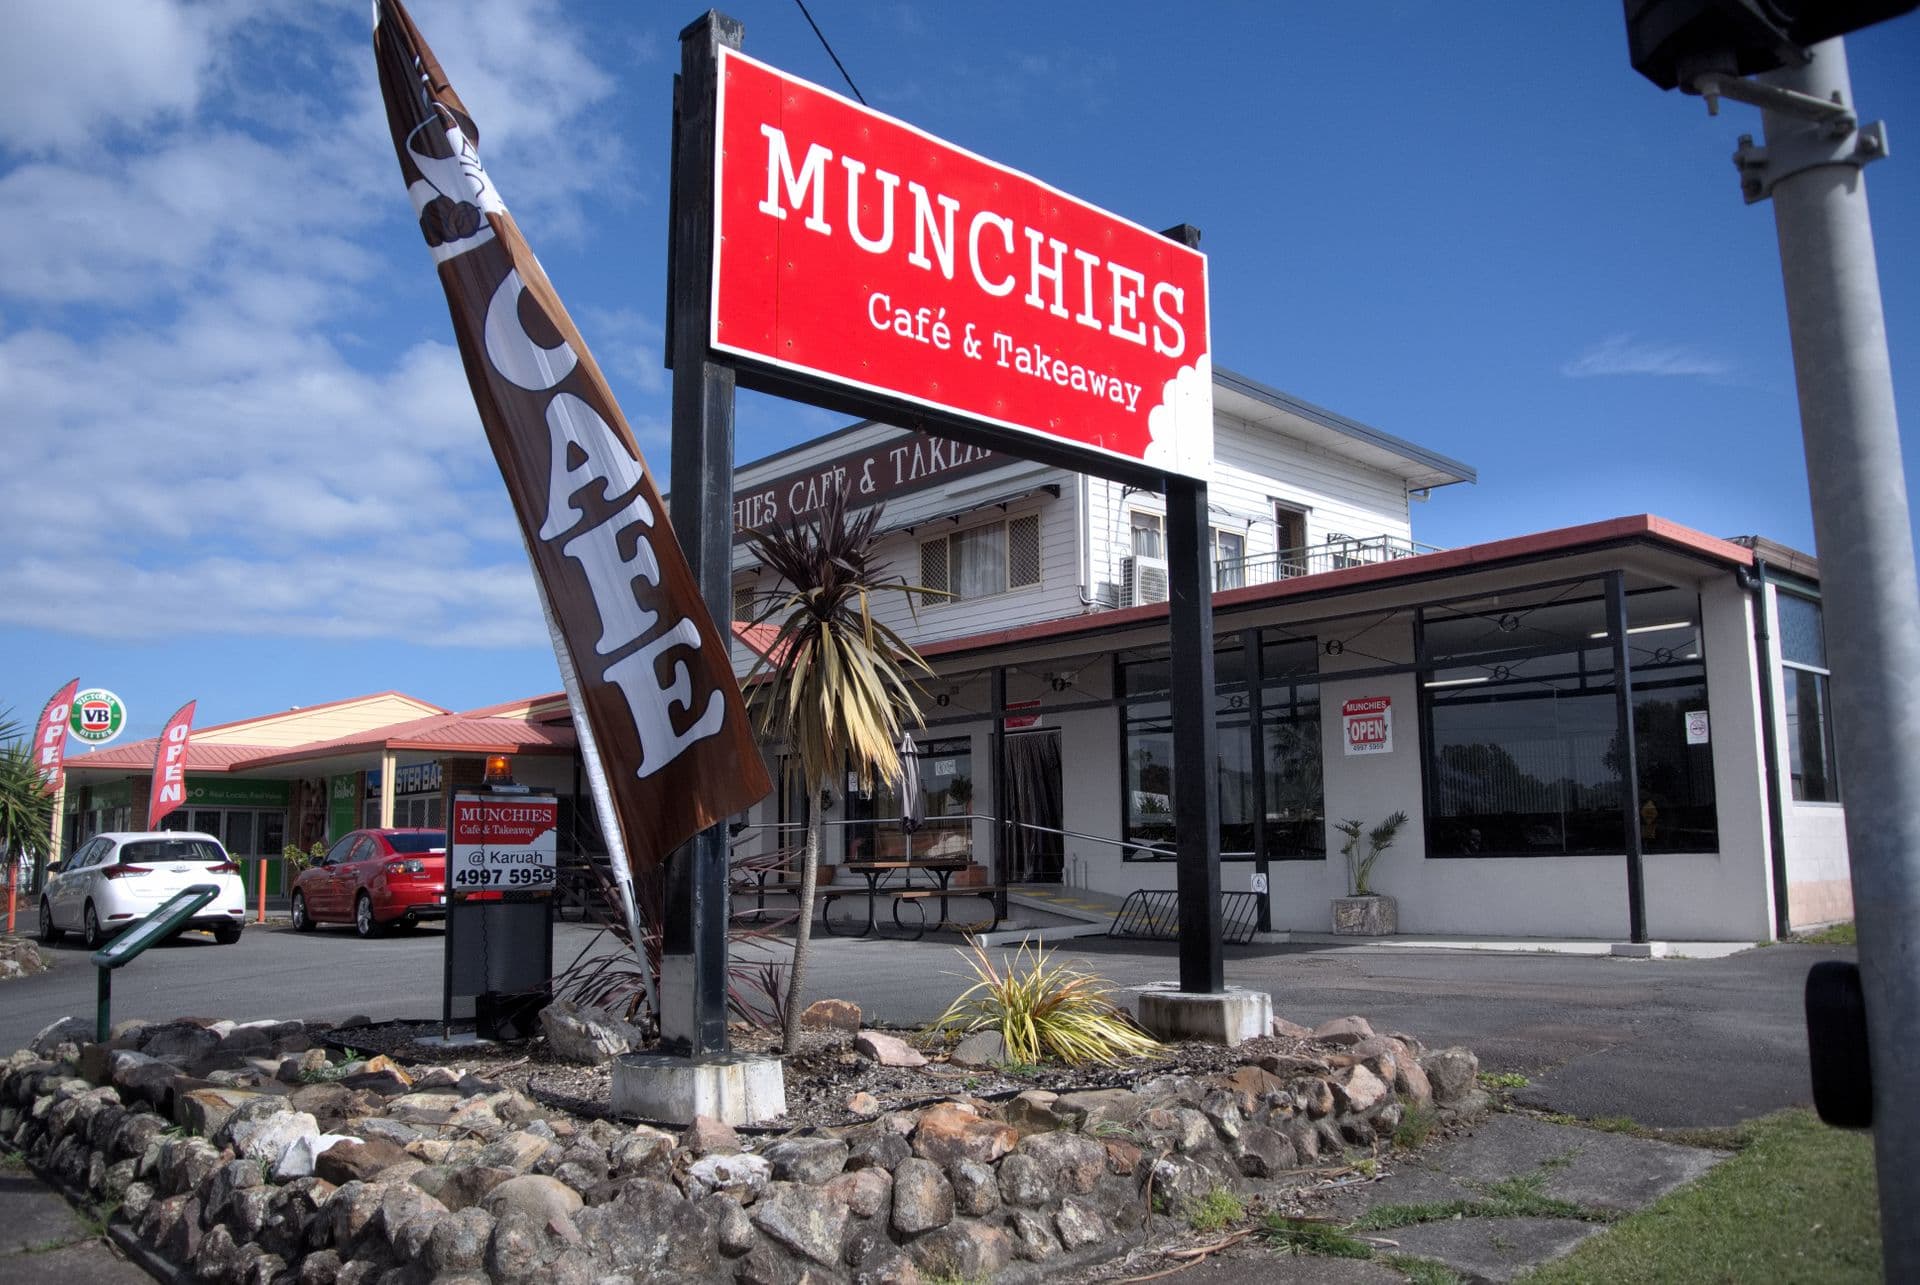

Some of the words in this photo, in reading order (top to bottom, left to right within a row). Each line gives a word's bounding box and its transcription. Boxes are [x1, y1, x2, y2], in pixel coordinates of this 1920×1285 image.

[758, 123, 1186, 358] MUNCHIES
[868, 292, 951, 349] Café
[963, 323, 982, 360] &
[993, 332, 1142, 412] Takeaway
[733, 491, 777, 533] HIES
[860, 458, 876, 494] &
[484, 267, 725, 778] CAFE
[76, 693, 115, 706] VICTORIA
[1346, 700, 1387, 713] MUNCHIES
[84, 709, 109, 722] VB
[80, 729, 112, 739] BITTER
[1351, 719, 1383, 741] OPEN
[40, 704, 69, 785] OPEN
[160, 724, 188, 803] OPEN
[396, 767, 420, 792] STER
[460, 808, 552, 822] MUNCHIES
[492, 824, 536, 837] Takeaway
[468, 851, 485, 866] @
[490, 851, 543, 864] Karuah
[456, 869, 503, 885] 4997
[509, 868, 554, 884] 5959
